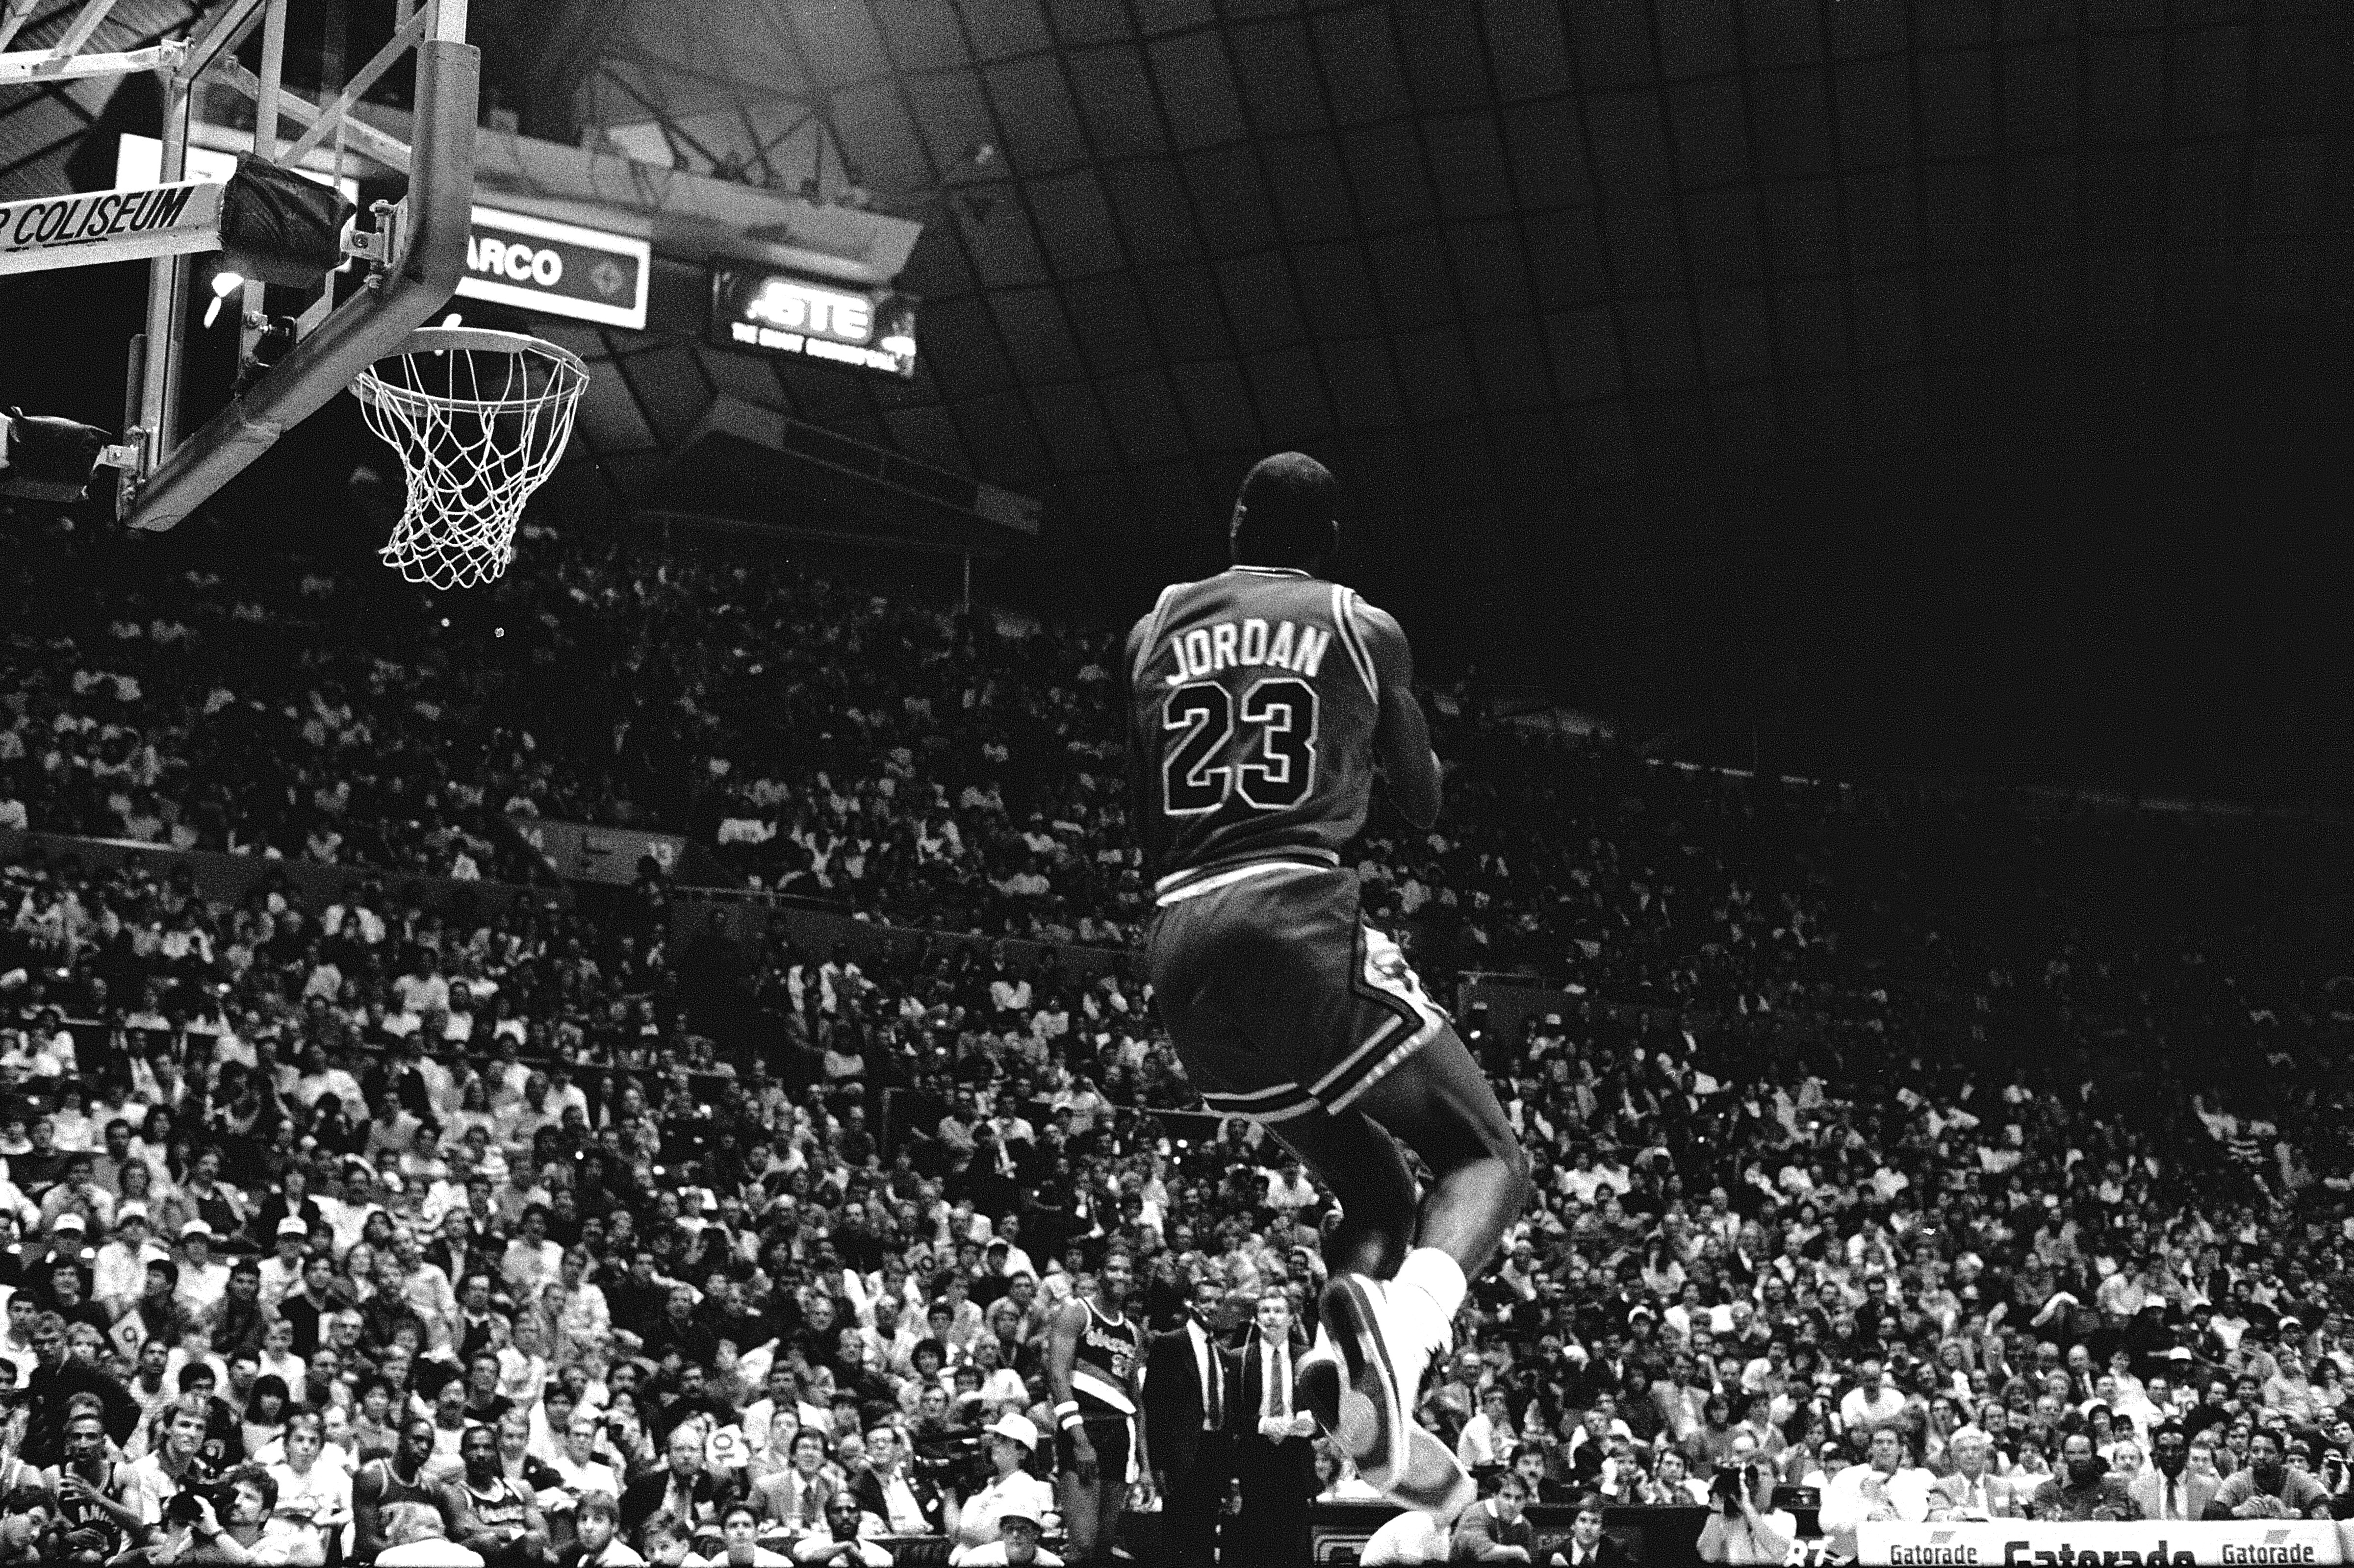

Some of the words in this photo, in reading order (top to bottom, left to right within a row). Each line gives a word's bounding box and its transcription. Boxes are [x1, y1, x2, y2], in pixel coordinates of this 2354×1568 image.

[14, 186, 195, 244] COLISEUM
[1166, 619, 1331, 685] JORDAN
[1162, 677, 1319, 815] 23
[1891, 1544, 1977, 1565] Gatorade
[2222, 1543, 2314, 1564] Gatorade
